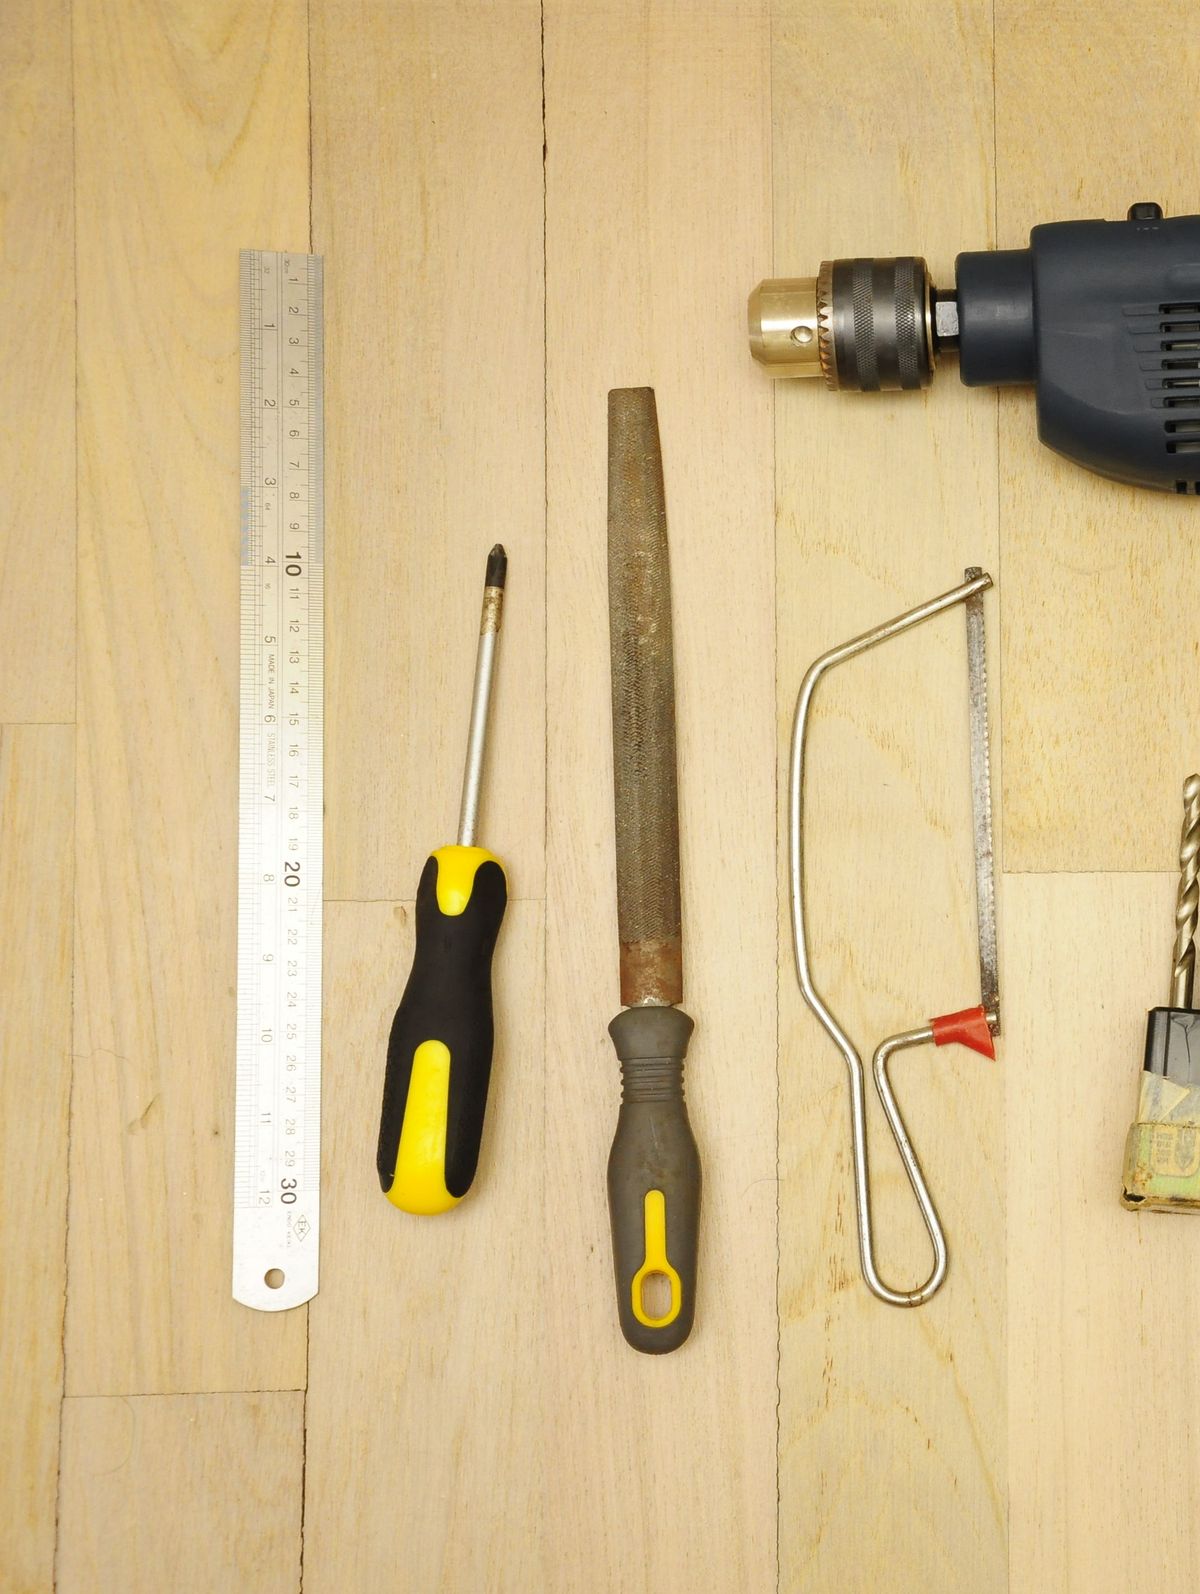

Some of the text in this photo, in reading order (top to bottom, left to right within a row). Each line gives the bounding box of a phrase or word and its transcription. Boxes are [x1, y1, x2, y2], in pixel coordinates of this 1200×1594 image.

[289, 306, 299, 314] 2
[289, 337, 299, 345] 3
[264, 399, 276, 407] 2
[289, 429, 300, 437] 6
[264, 477, 276, 486] 3
[289, 491, 300, 499] 8
[289, 522, 300, 530] 9
[265, 556, 276, 564] 4
[285, 551, 302, 577] 10
[289, 588, 299, 599] 11
[289, 620, 300, 633] 12
[264, 635, 276, 644] 5
[289, 650, 300, 664] 13
[289, 681, 299, 694] 14
[264, 714, 276, 723] 6
[289, 713, 299, 726] 15
[288, 744, 299, 757] 16
[289, 775, 299, 788] 17
[288, 806, 299, 820] 18
[288, 838, 299, 851] 19
[263, 874, 275, 882] 8
[284, 861, 301, 887] 20
[288, 897, 298, 912] 21
[287, 929, 298, 945] 22
[262, 953, 274, 962] 9
[287, 960, 297, 977] 23
[287, 991, 297, 1007] 24
[261, 1028, 272, 1043] 10
[286, 1023, 297, 1040] 25
[286, 1055, 297, 1072] 26
[260, 1112, 271, 1123] 11
[285, 1119, 296, 1136] 28
[259, 1190, 271, 1205] 12
[280, 1178, 297, 1205] 30
